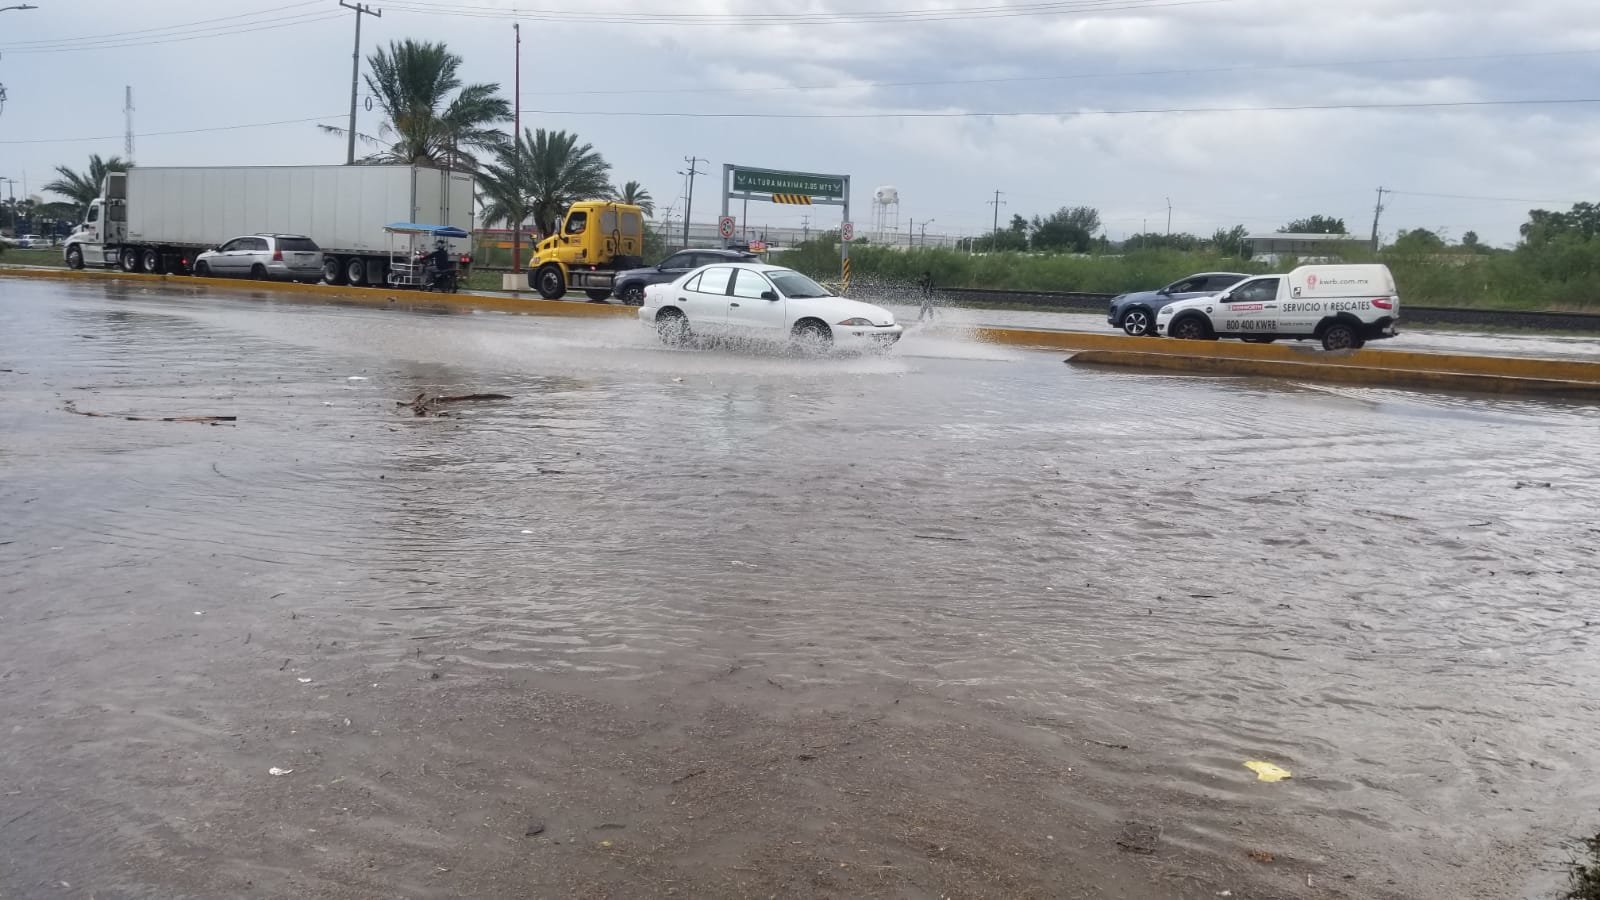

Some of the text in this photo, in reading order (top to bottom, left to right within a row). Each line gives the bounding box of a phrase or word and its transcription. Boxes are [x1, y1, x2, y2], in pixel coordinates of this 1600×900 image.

[748, 178, 775, 187] ALTURA
[777, 180, 803, 189] MAXIMA
[1283, 301, 1370, 313] SERVICIO Y RESCATES
[1226, 320, 1239, 330] 800
[1241, 320, 1254, 330] 400
